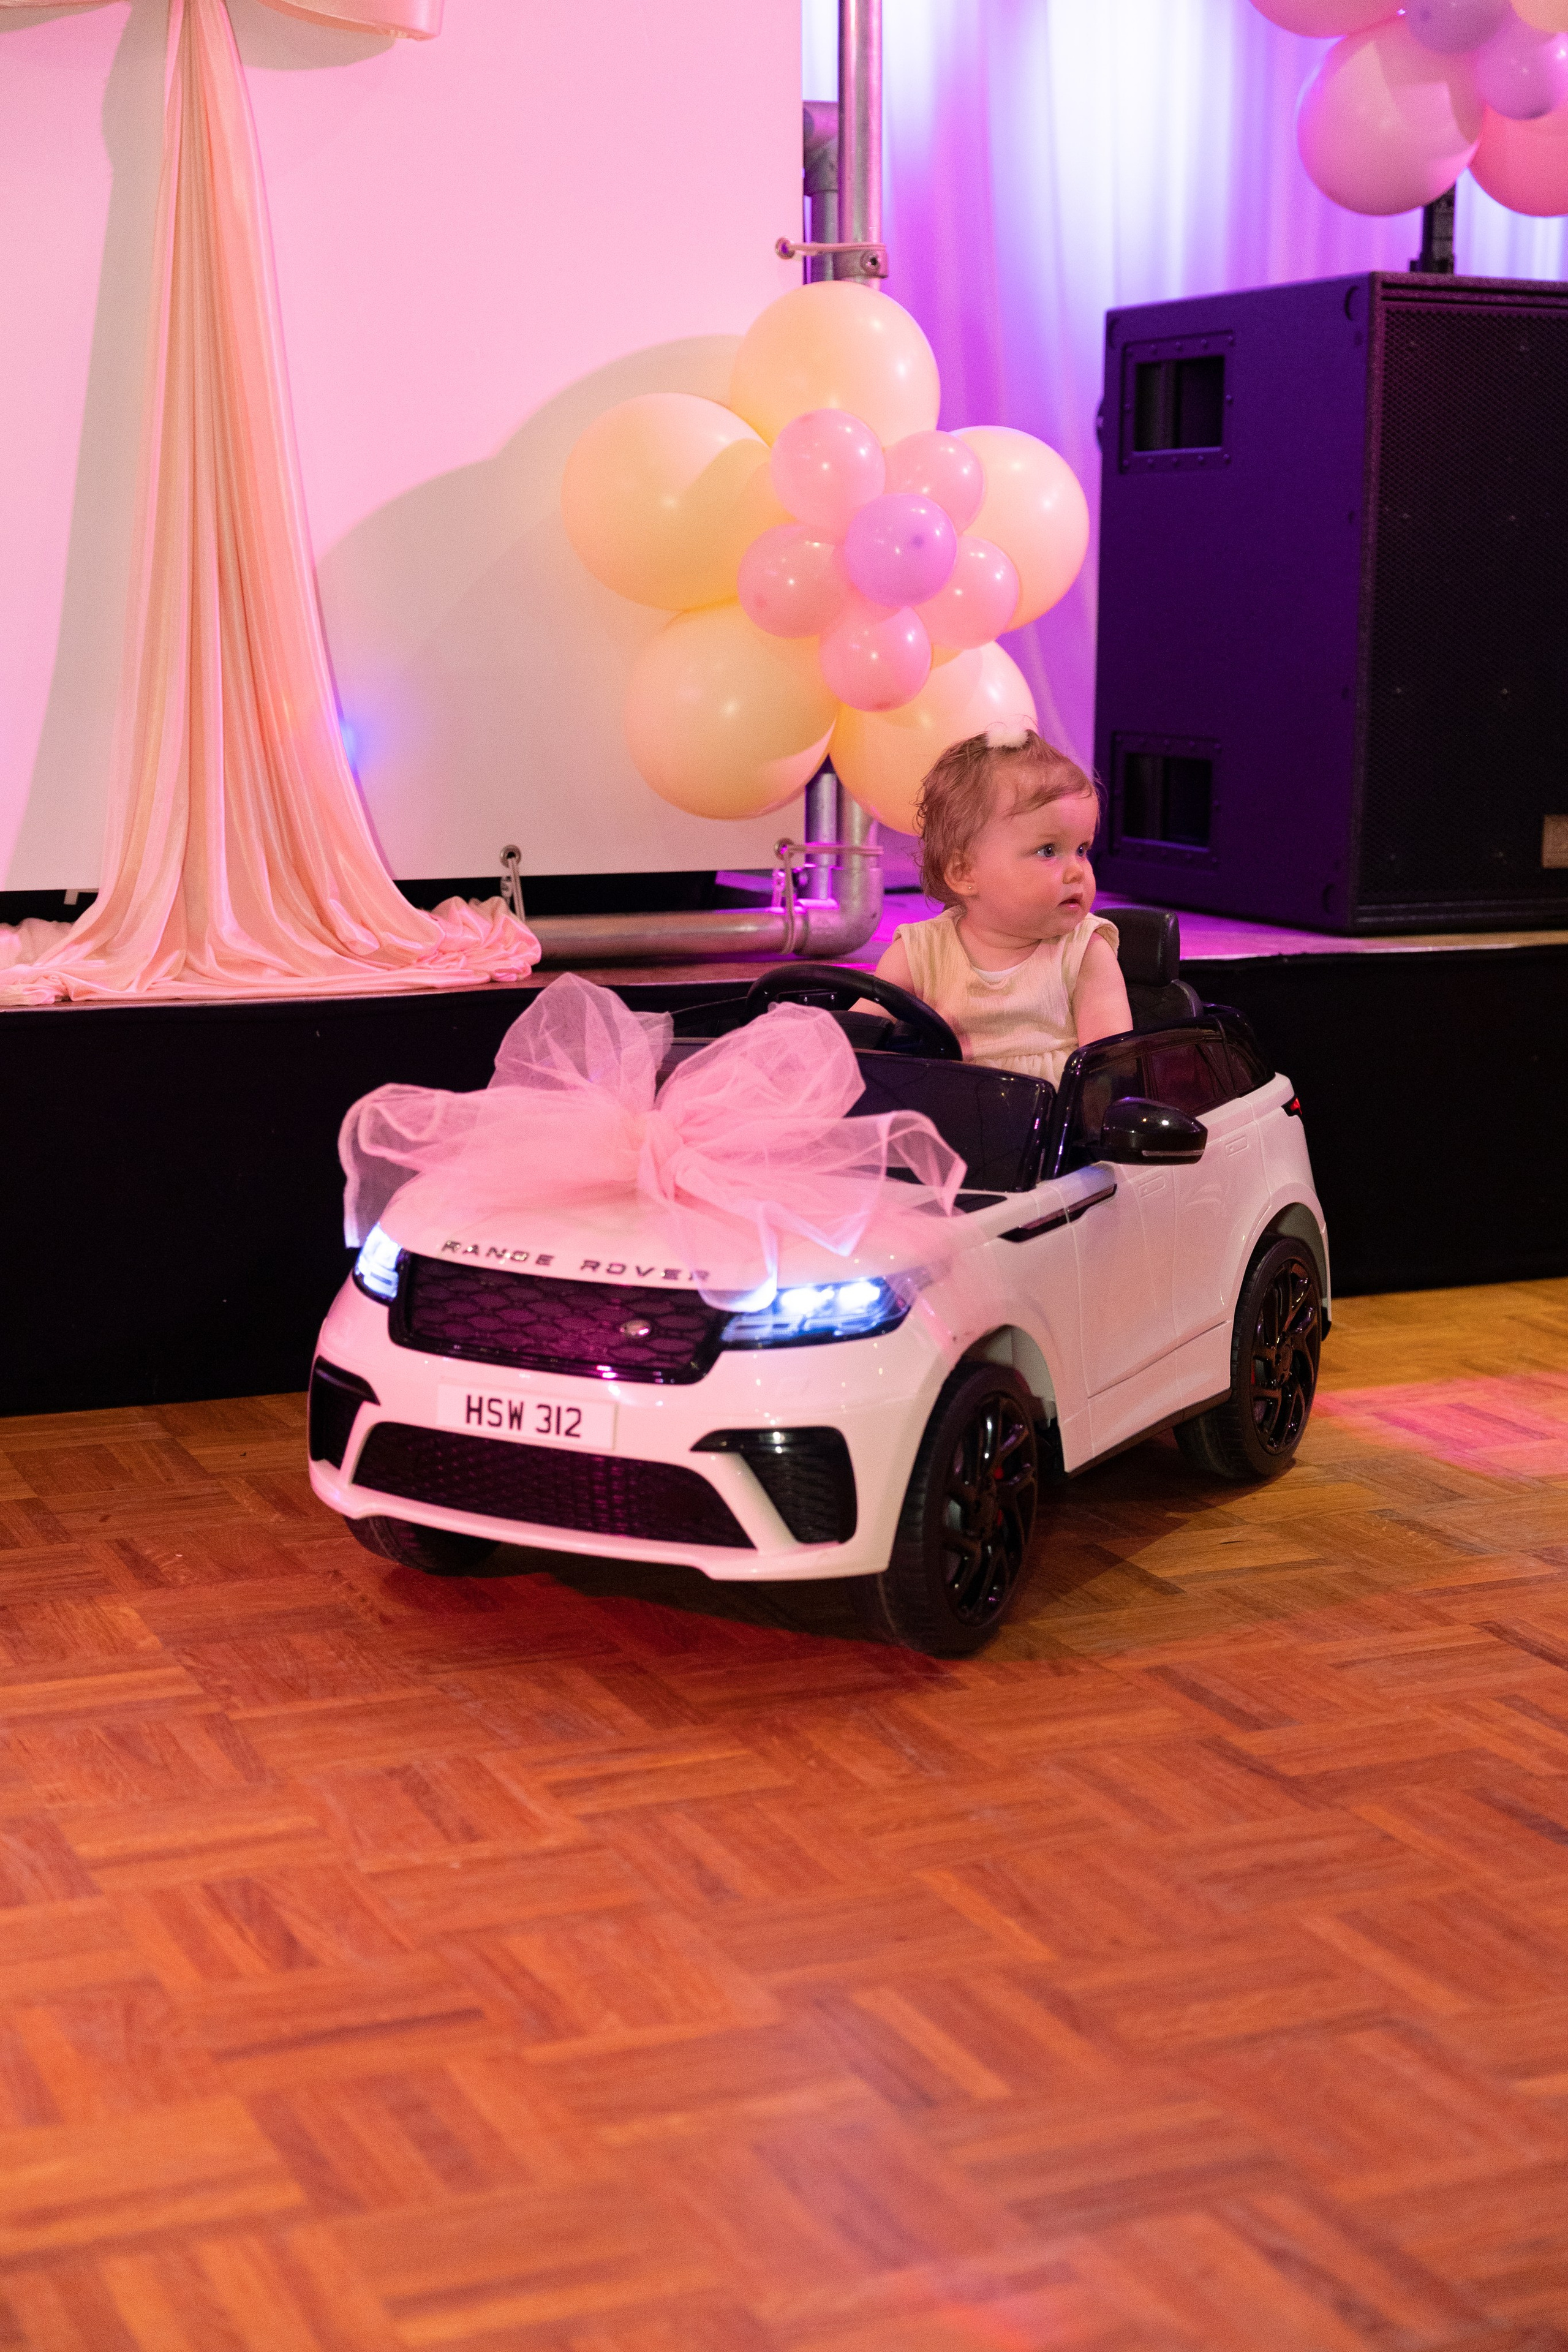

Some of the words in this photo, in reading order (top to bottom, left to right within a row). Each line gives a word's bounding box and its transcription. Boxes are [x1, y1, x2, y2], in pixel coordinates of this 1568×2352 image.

[442, 1240, 554, 1266] RANGE
[581, 1259, 709, 1282] ROVER
[466, 1395, 524, 1431] HSW
[535, 1404, 582, 1438] 312
